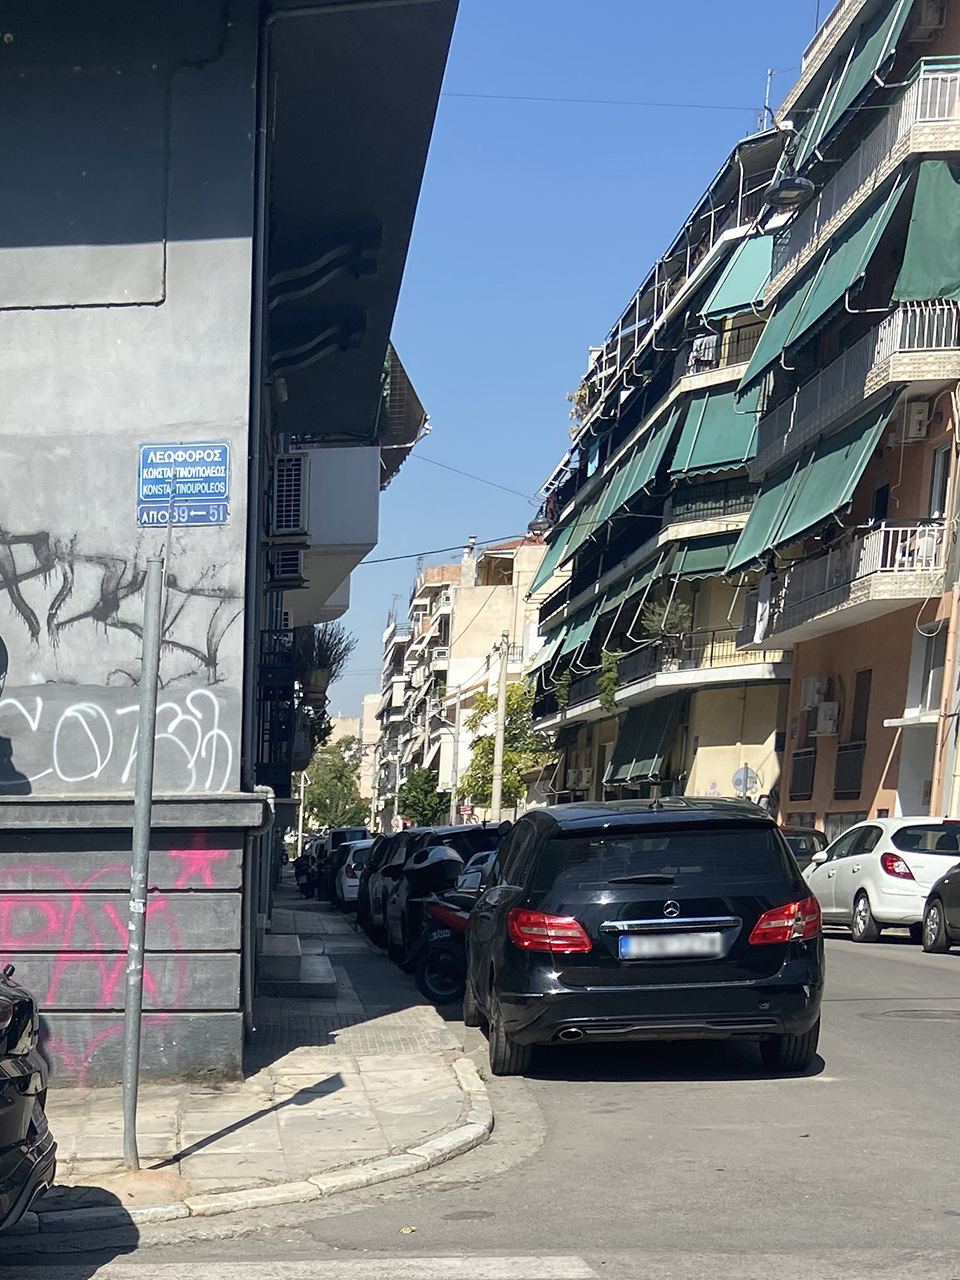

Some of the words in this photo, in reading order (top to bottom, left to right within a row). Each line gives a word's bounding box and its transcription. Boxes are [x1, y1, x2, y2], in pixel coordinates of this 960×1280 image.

[147, 449, 222, 463] ΛΕΩΦΟΡΟΣ
[143, 482, 225, 495] KONSTATINOUPOLEOS
[141, 511, 169, 524] ΑΠΟ
[209, 505, 224, 521] 51
